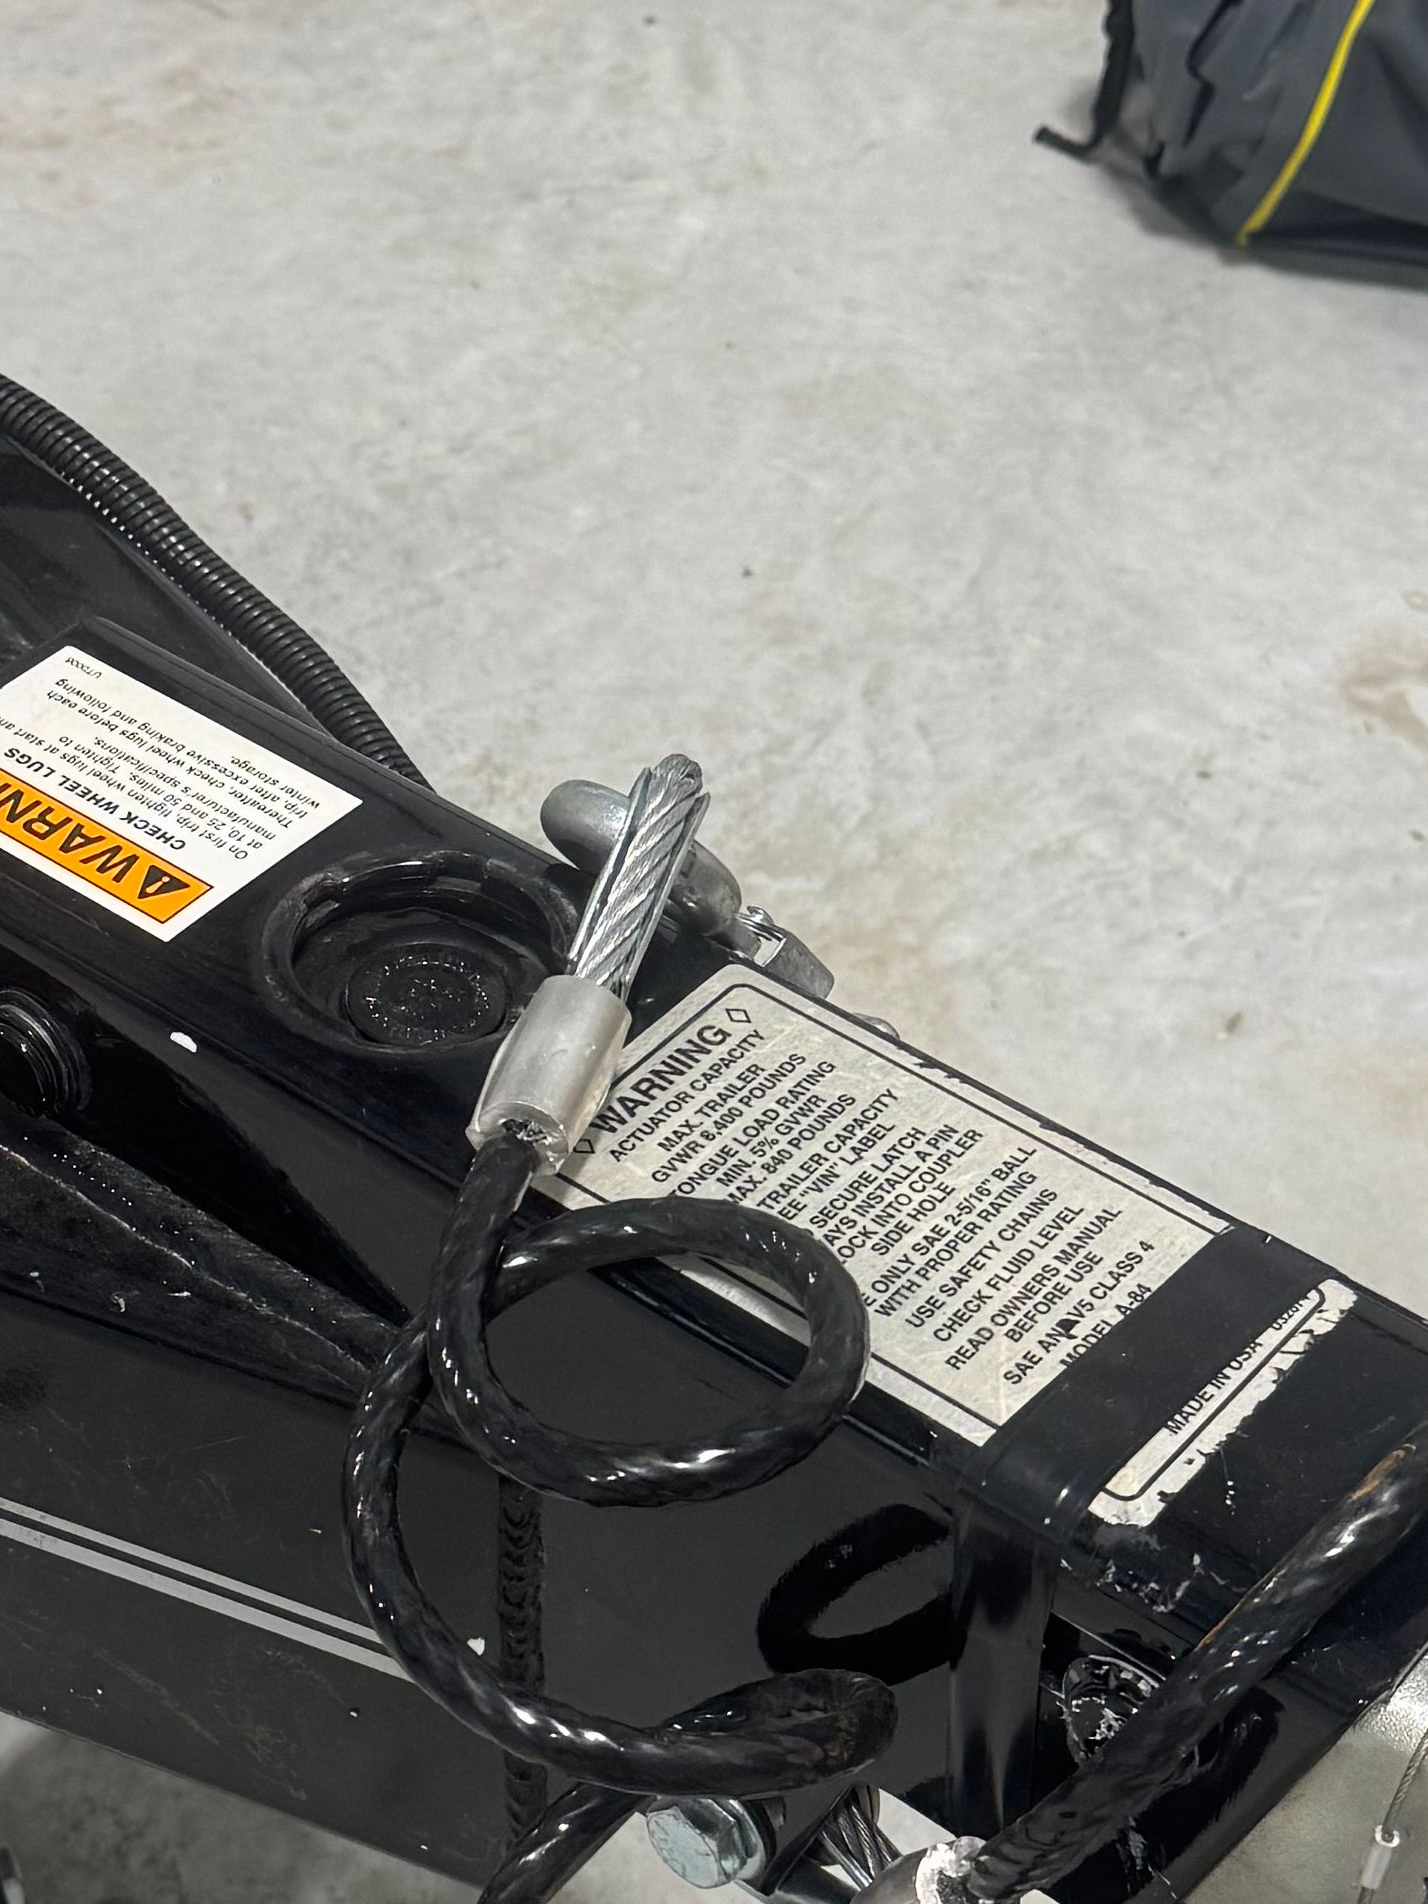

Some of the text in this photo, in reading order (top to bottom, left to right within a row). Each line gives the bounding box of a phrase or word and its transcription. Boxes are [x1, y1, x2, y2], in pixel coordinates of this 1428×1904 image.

[13, 728, 46, 746] start
[43, 744, 60, 754] at
[46, 690, 293, 829] Thereafter, check wheel lugs before each
[54, 678, 308, 819] trip, after excessive braking and following
[59, 752, 89, 772] lugs
[86, 768, 126, 792] wheel
[230, 756, 320, 809] winter storage.
[3, 747, 186, 851] CHECK WHEEL LUGS
[58, 736, 263, 849] at 10, 25 and 50 miles. Tighten to
[93, 736, 276, 841] manufacturer's specifications.
[127, 789, 173, 818] tighten
[176, 813, 200, 833] trip,
[198, 829, 228, 849] first
[228, 844, 249, 860] On
[589, 1025, 732, 1134] WARNING
[609, 1029, 765, 1163] ACTUATOR CAPACITY
[651, 1053, 806, 1183] GVWR 8,400 POUNDS
[657, 1063, 766, 1152] MAX. TRAILER
[732, 1108, 780, 1147] LOAD
[775, 1061, 836, 1110] RATING
[715, 1094, 827, 1187] MIN. 5% GVWR
[756, 1088, 898, 1210] TRAILER CAPACITY
[760, 1148, 794, 1174] 840
[787, 1094, 856, 1151] POUNDS
[777, 1198, 808, 1221] EE
[839, 1123, 896, 1166] LABEL
[809, 1127, 926, 1229] SECURE LATCH
[851, 1164, 920, 1218] INSTALL
[914, 1150, 933, 1163] A
[925, 1124, 959, 1151] PIN
[870, 1193, 913, 1228] INTO
[908, 1129, 983, 1193] COUPLER
[870, 1182, 956, 1256] SIDE HOLE
[871, 1253, 916, 1294] ONLY
[911, 1224, 951, 1256] SAE
[990, 1147, 1037, 1182] BALL
[873, 1171, 1037, 1317] WITH PROPER RATING
[905, 1188, 1058, 1328] USE SAFETY CHAINS
[933, 1206, 1085, 1342] CHECK FLUID LEVEL
[945, 1209, 1122, 1370] READ OWNERS MANUAL
[1003, 1240, 1155, 1385] SAE AN V5 CLASS 4
[1004, 1251, 1104, 1343] BEFORE USE
[1115, 1283, 1152, 1318] A-84
[1165, 1386, 1215, 1435] MADE
[1205, 1368, 1231, 1390] IN
